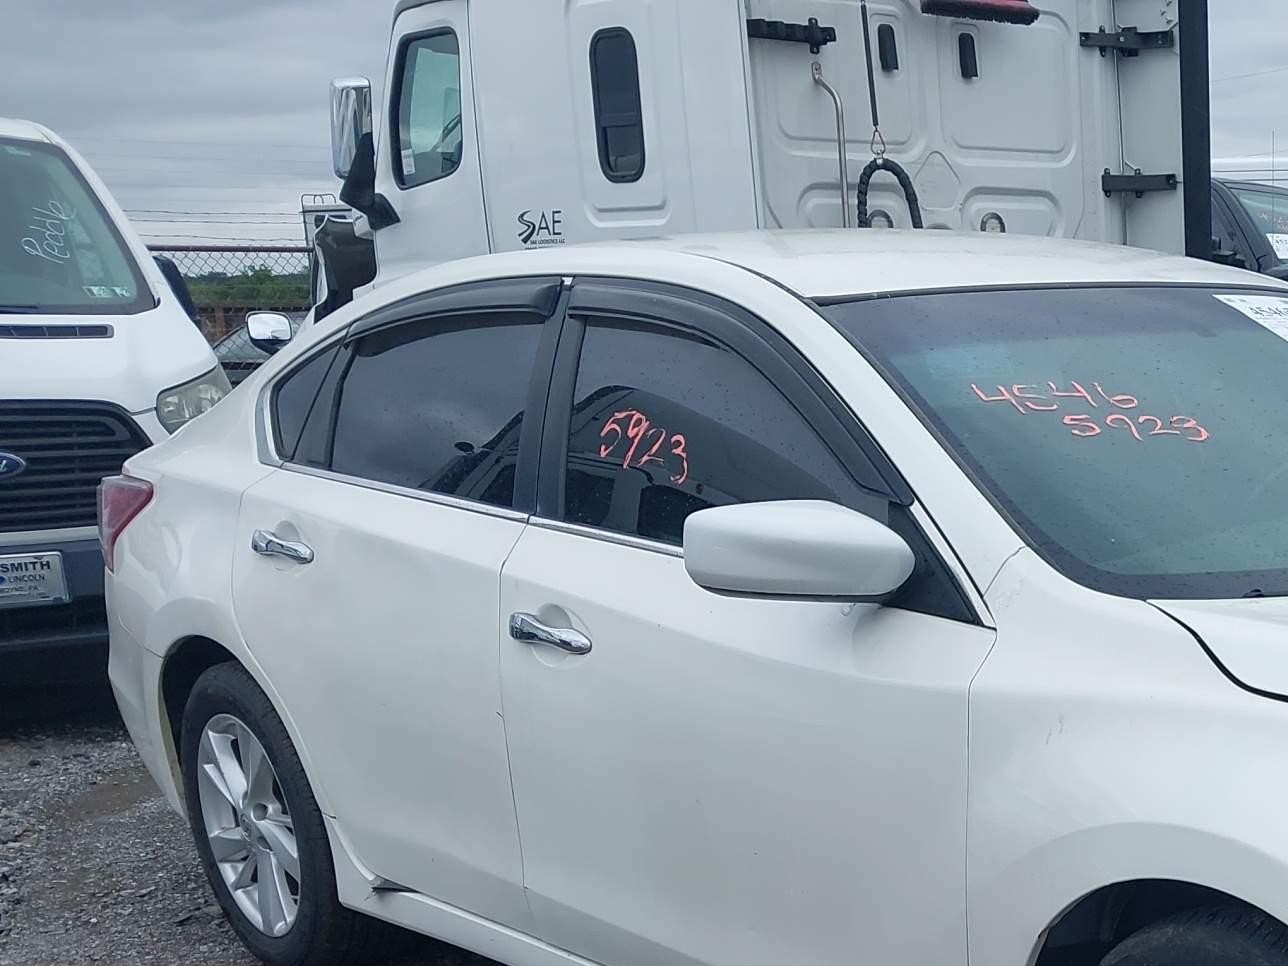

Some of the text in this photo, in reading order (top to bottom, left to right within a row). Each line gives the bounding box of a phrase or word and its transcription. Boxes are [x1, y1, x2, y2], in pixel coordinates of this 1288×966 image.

[517, 209, 562, 244] SAE
[970, 381, 1137, 414] 4546
[1063, 414, 1209, 441] 5923
[600, 409, 688, 485] 5923
[0, 560, 51, 573] SMITH
